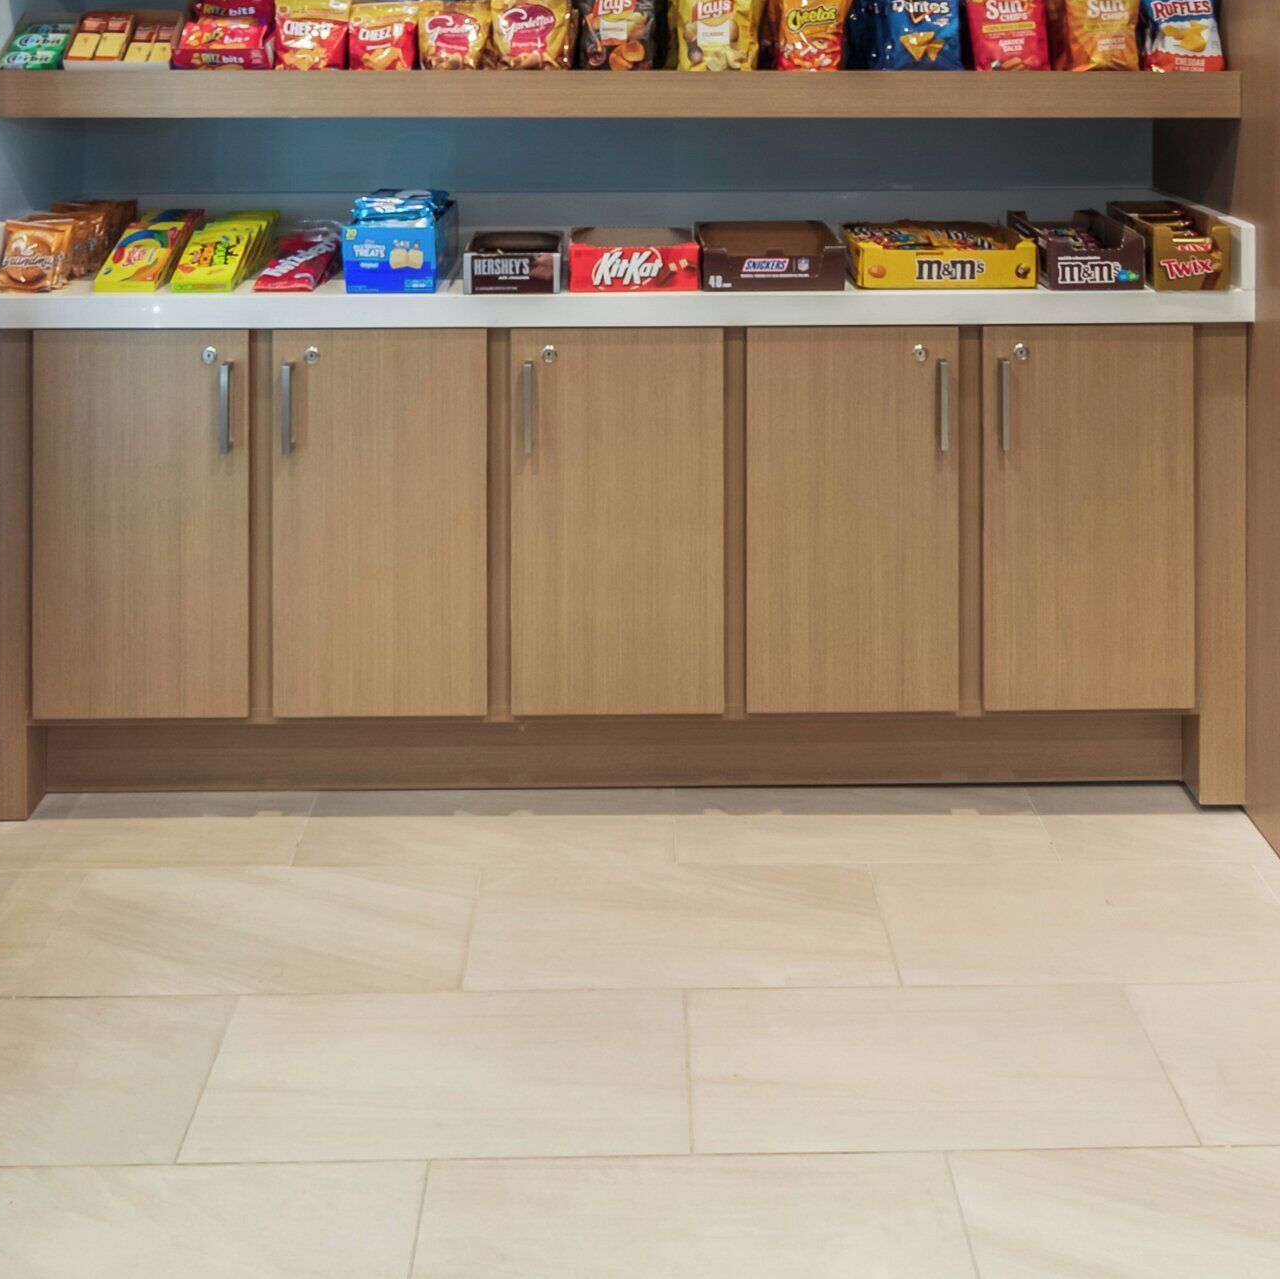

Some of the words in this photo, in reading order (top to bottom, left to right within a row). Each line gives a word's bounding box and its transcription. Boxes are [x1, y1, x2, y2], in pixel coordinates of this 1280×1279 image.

[229, 6, 256, 17] bits
[697, 0, 732, 20] Lay's
[892, 0, 950, 14] Doritos
[788, 6, 838, 31] Cheetos
[222, 55, 244, 64] bits
[474, 258, 530, 275] HERSHEY'S
[745, 260, 786, 270] SNICKERS
